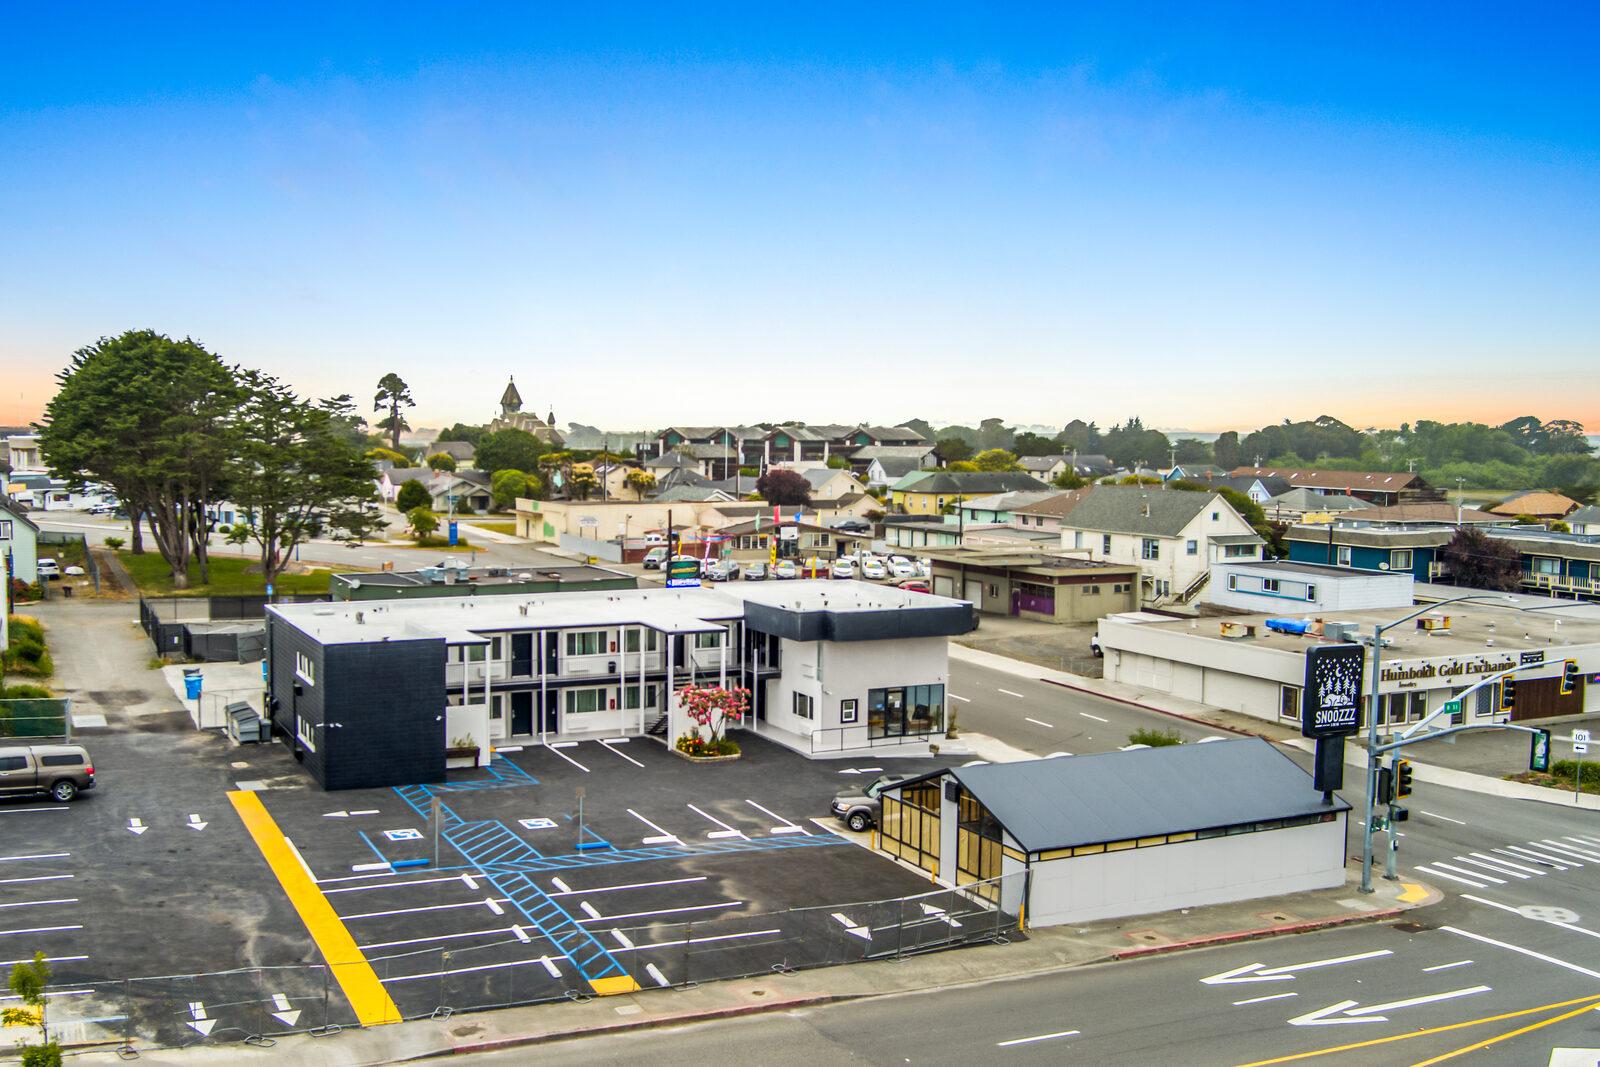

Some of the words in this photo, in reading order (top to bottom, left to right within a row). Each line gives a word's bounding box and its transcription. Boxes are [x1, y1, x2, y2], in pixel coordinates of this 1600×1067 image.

[1380, 665, 1436, 682] Humboldt
[1438, 663, 1464, 677] Gold
[1465, 660, 1517, 675] Exchange
[1575, 733, 1586, 741] 101
